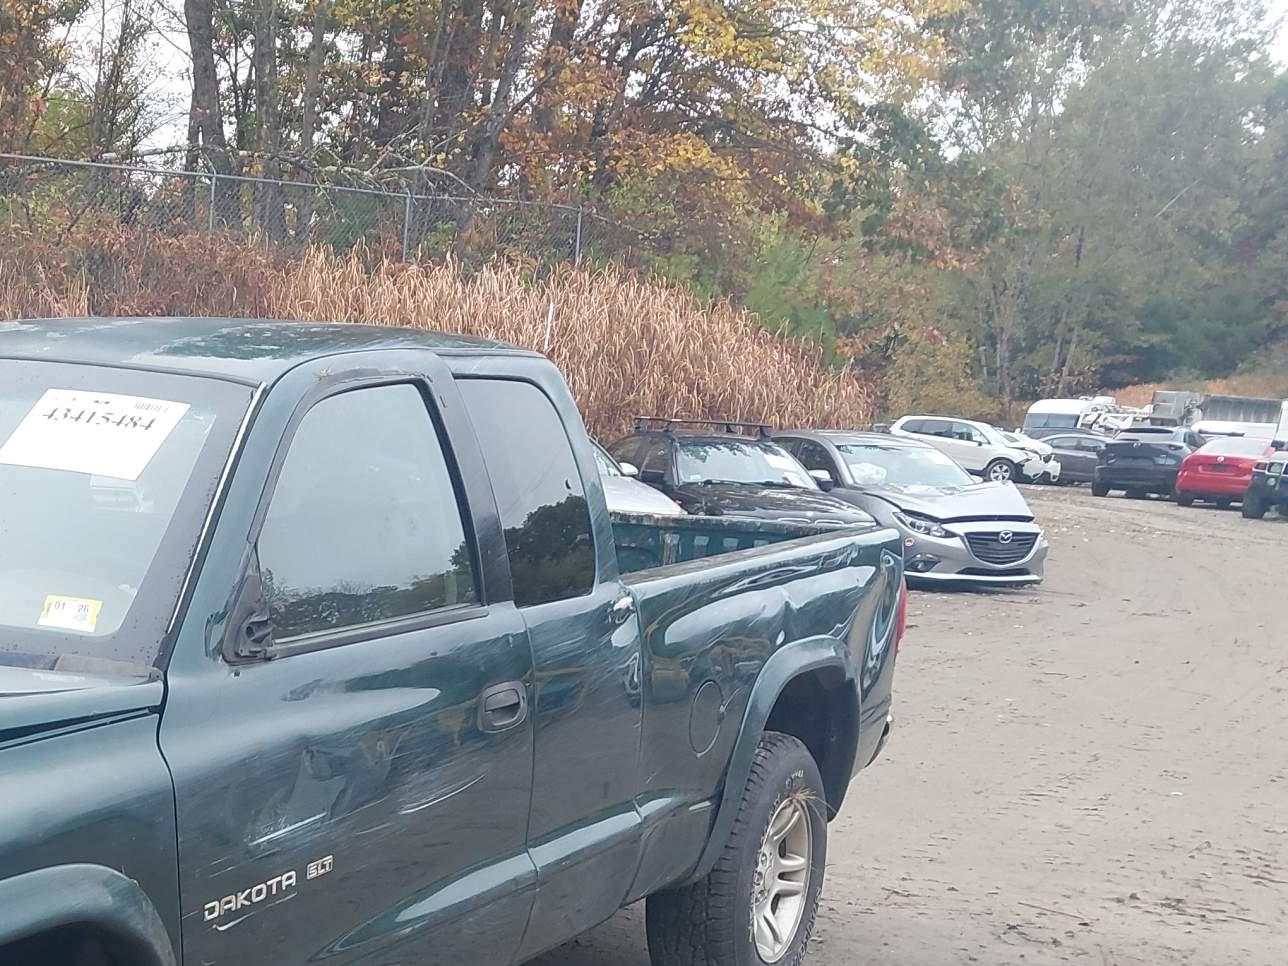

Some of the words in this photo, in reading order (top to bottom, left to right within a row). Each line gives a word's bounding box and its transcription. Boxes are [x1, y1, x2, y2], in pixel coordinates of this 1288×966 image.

[42, 407, 157, 431] 43415484
[203, 870, 297, 922] DAKOTA
[307, 855, 333, 880] SLT
